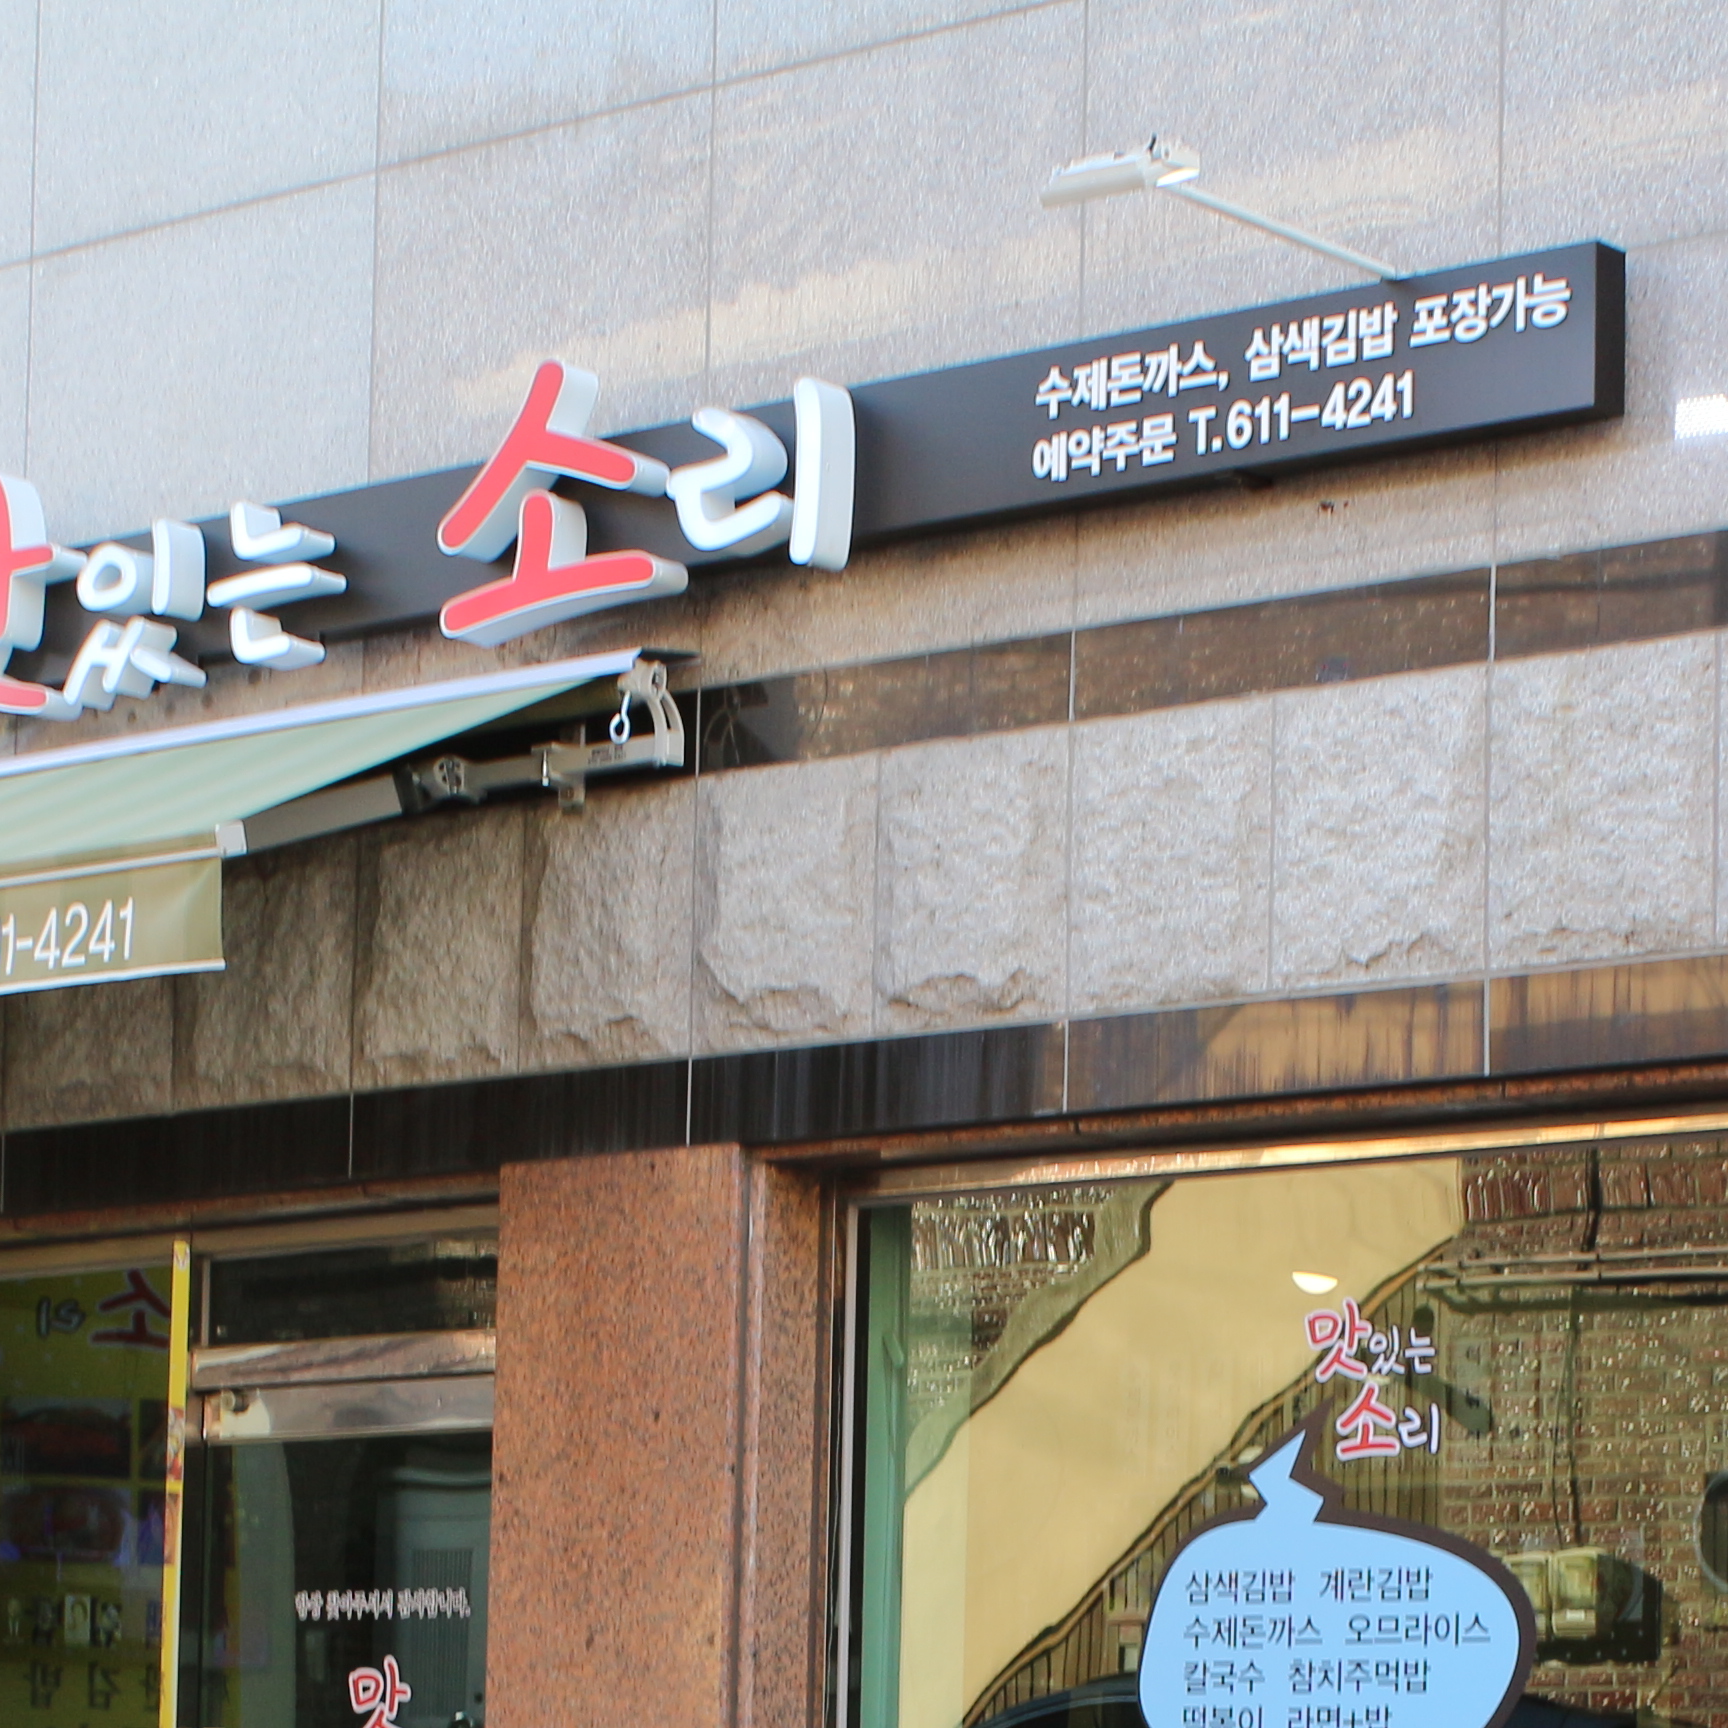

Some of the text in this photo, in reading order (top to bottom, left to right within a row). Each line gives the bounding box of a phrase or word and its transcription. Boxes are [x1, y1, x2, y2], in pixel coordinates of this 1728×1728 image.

[1034, 271, 1572, 420] 수제돈까스, 삼색김밥 포장가능
[1031, 368, 1416, 482] 예약주문 T.611-4241
[436, 358, 857, 648] 소리
[1304, 1296, 1437, 1383] 맛있는
[1335, 1382, 1442, 1462] 소리
[1184, 1566, 1433, 1606] 삼색김밥 계란김밥
[1183, 1611, 1492, 1650] 수제돈까스 오므라이스
[1183, 1658, 1431, 1697] 칼국수 참치주먹밥
